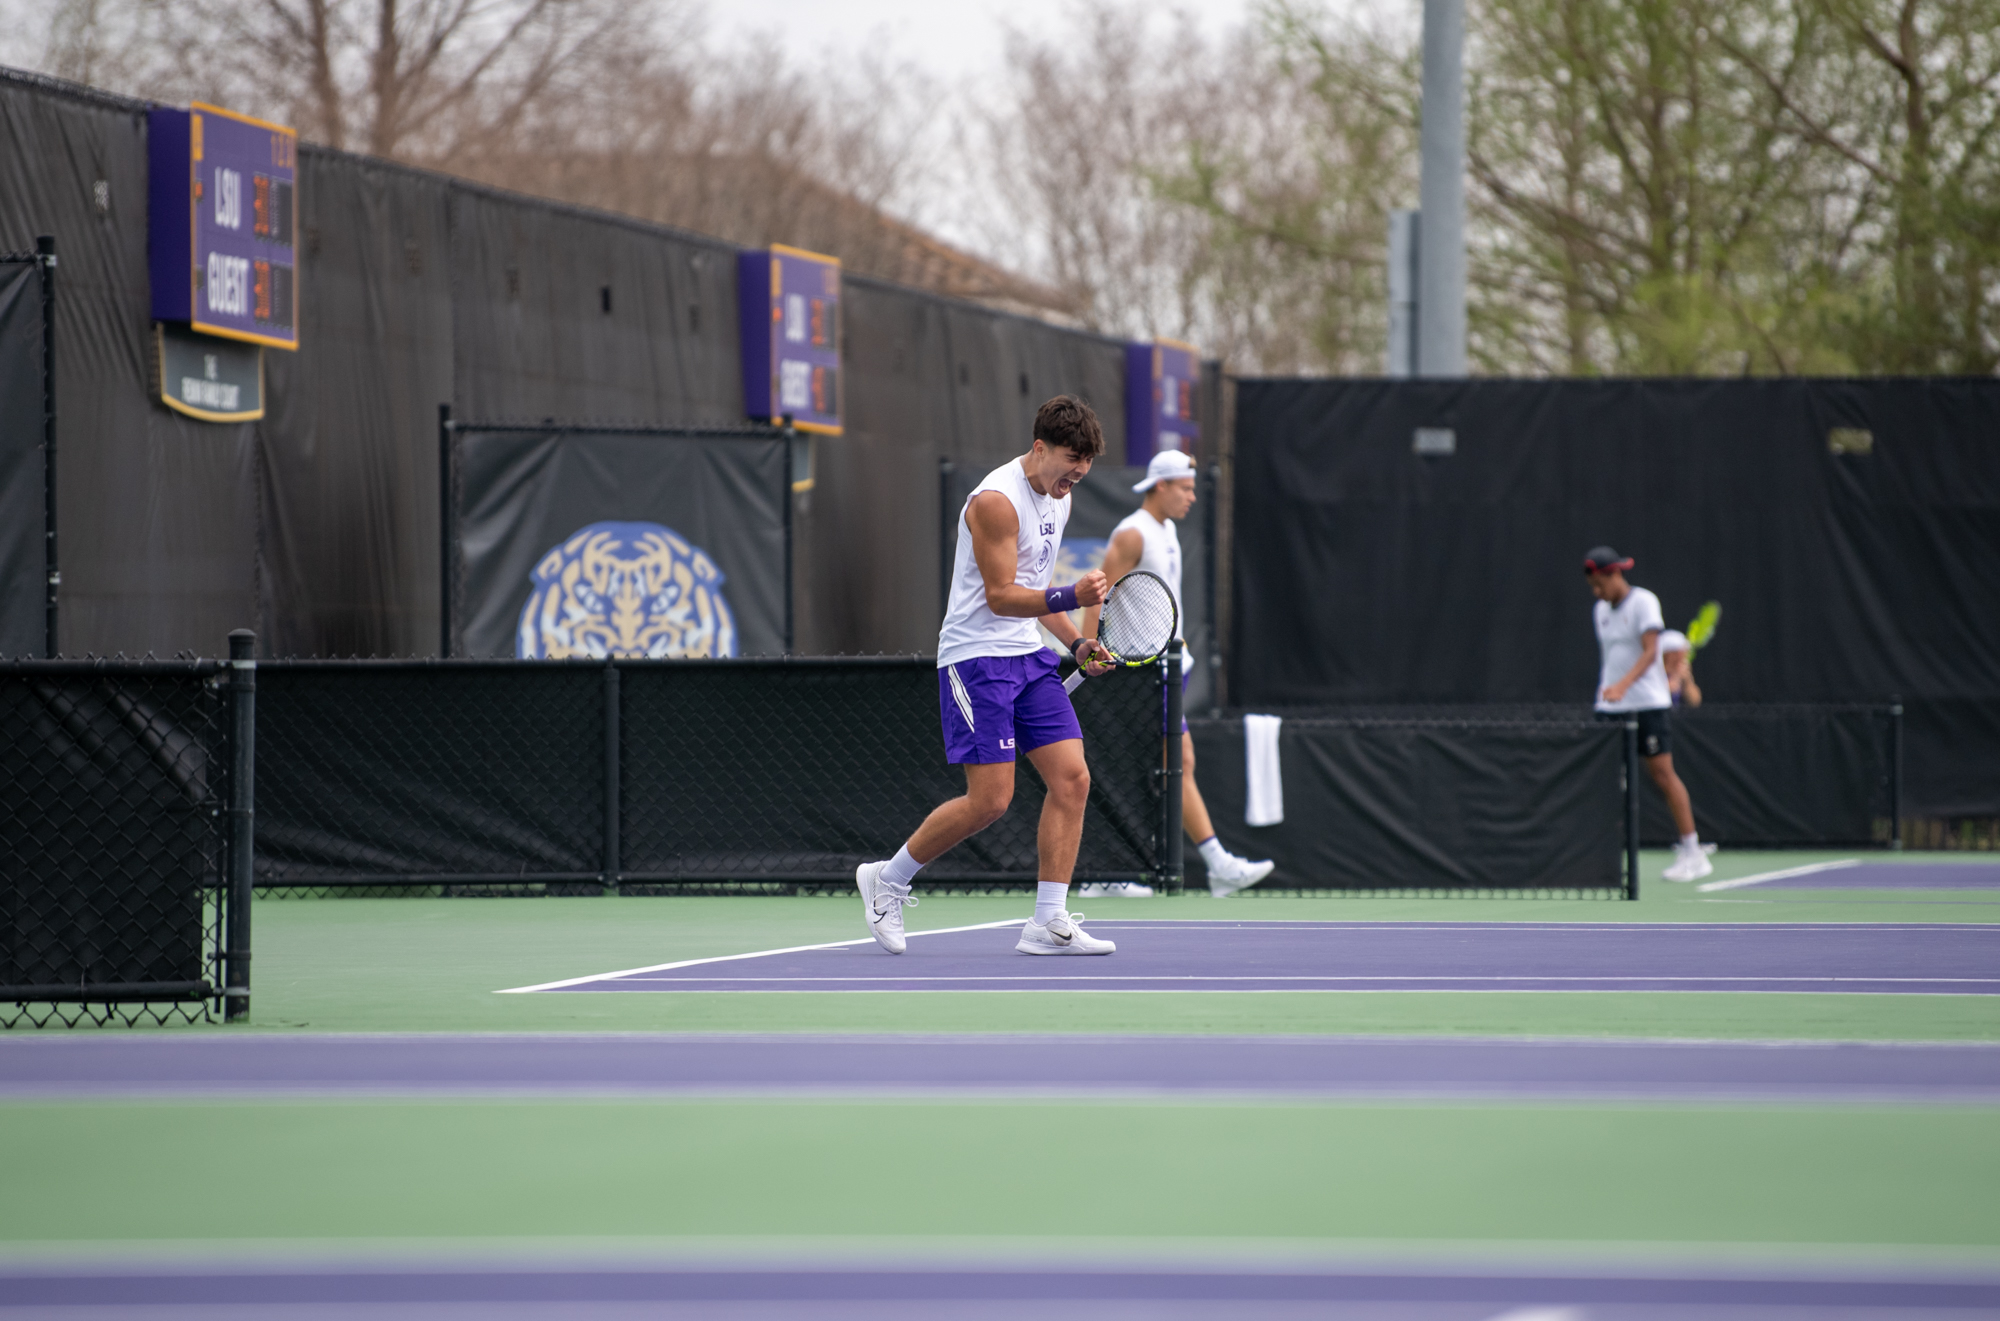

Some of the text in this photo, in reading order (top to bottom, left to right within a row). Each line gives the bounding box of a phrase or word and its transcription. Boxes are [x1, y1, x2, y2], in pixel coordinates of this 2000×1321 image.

[215, 166, 241, 230] LSU
[207, 251, 249, 317] GUEST
[1039, 522, 1055, 536] LSU
[999, 738, 1015, 749] LS
